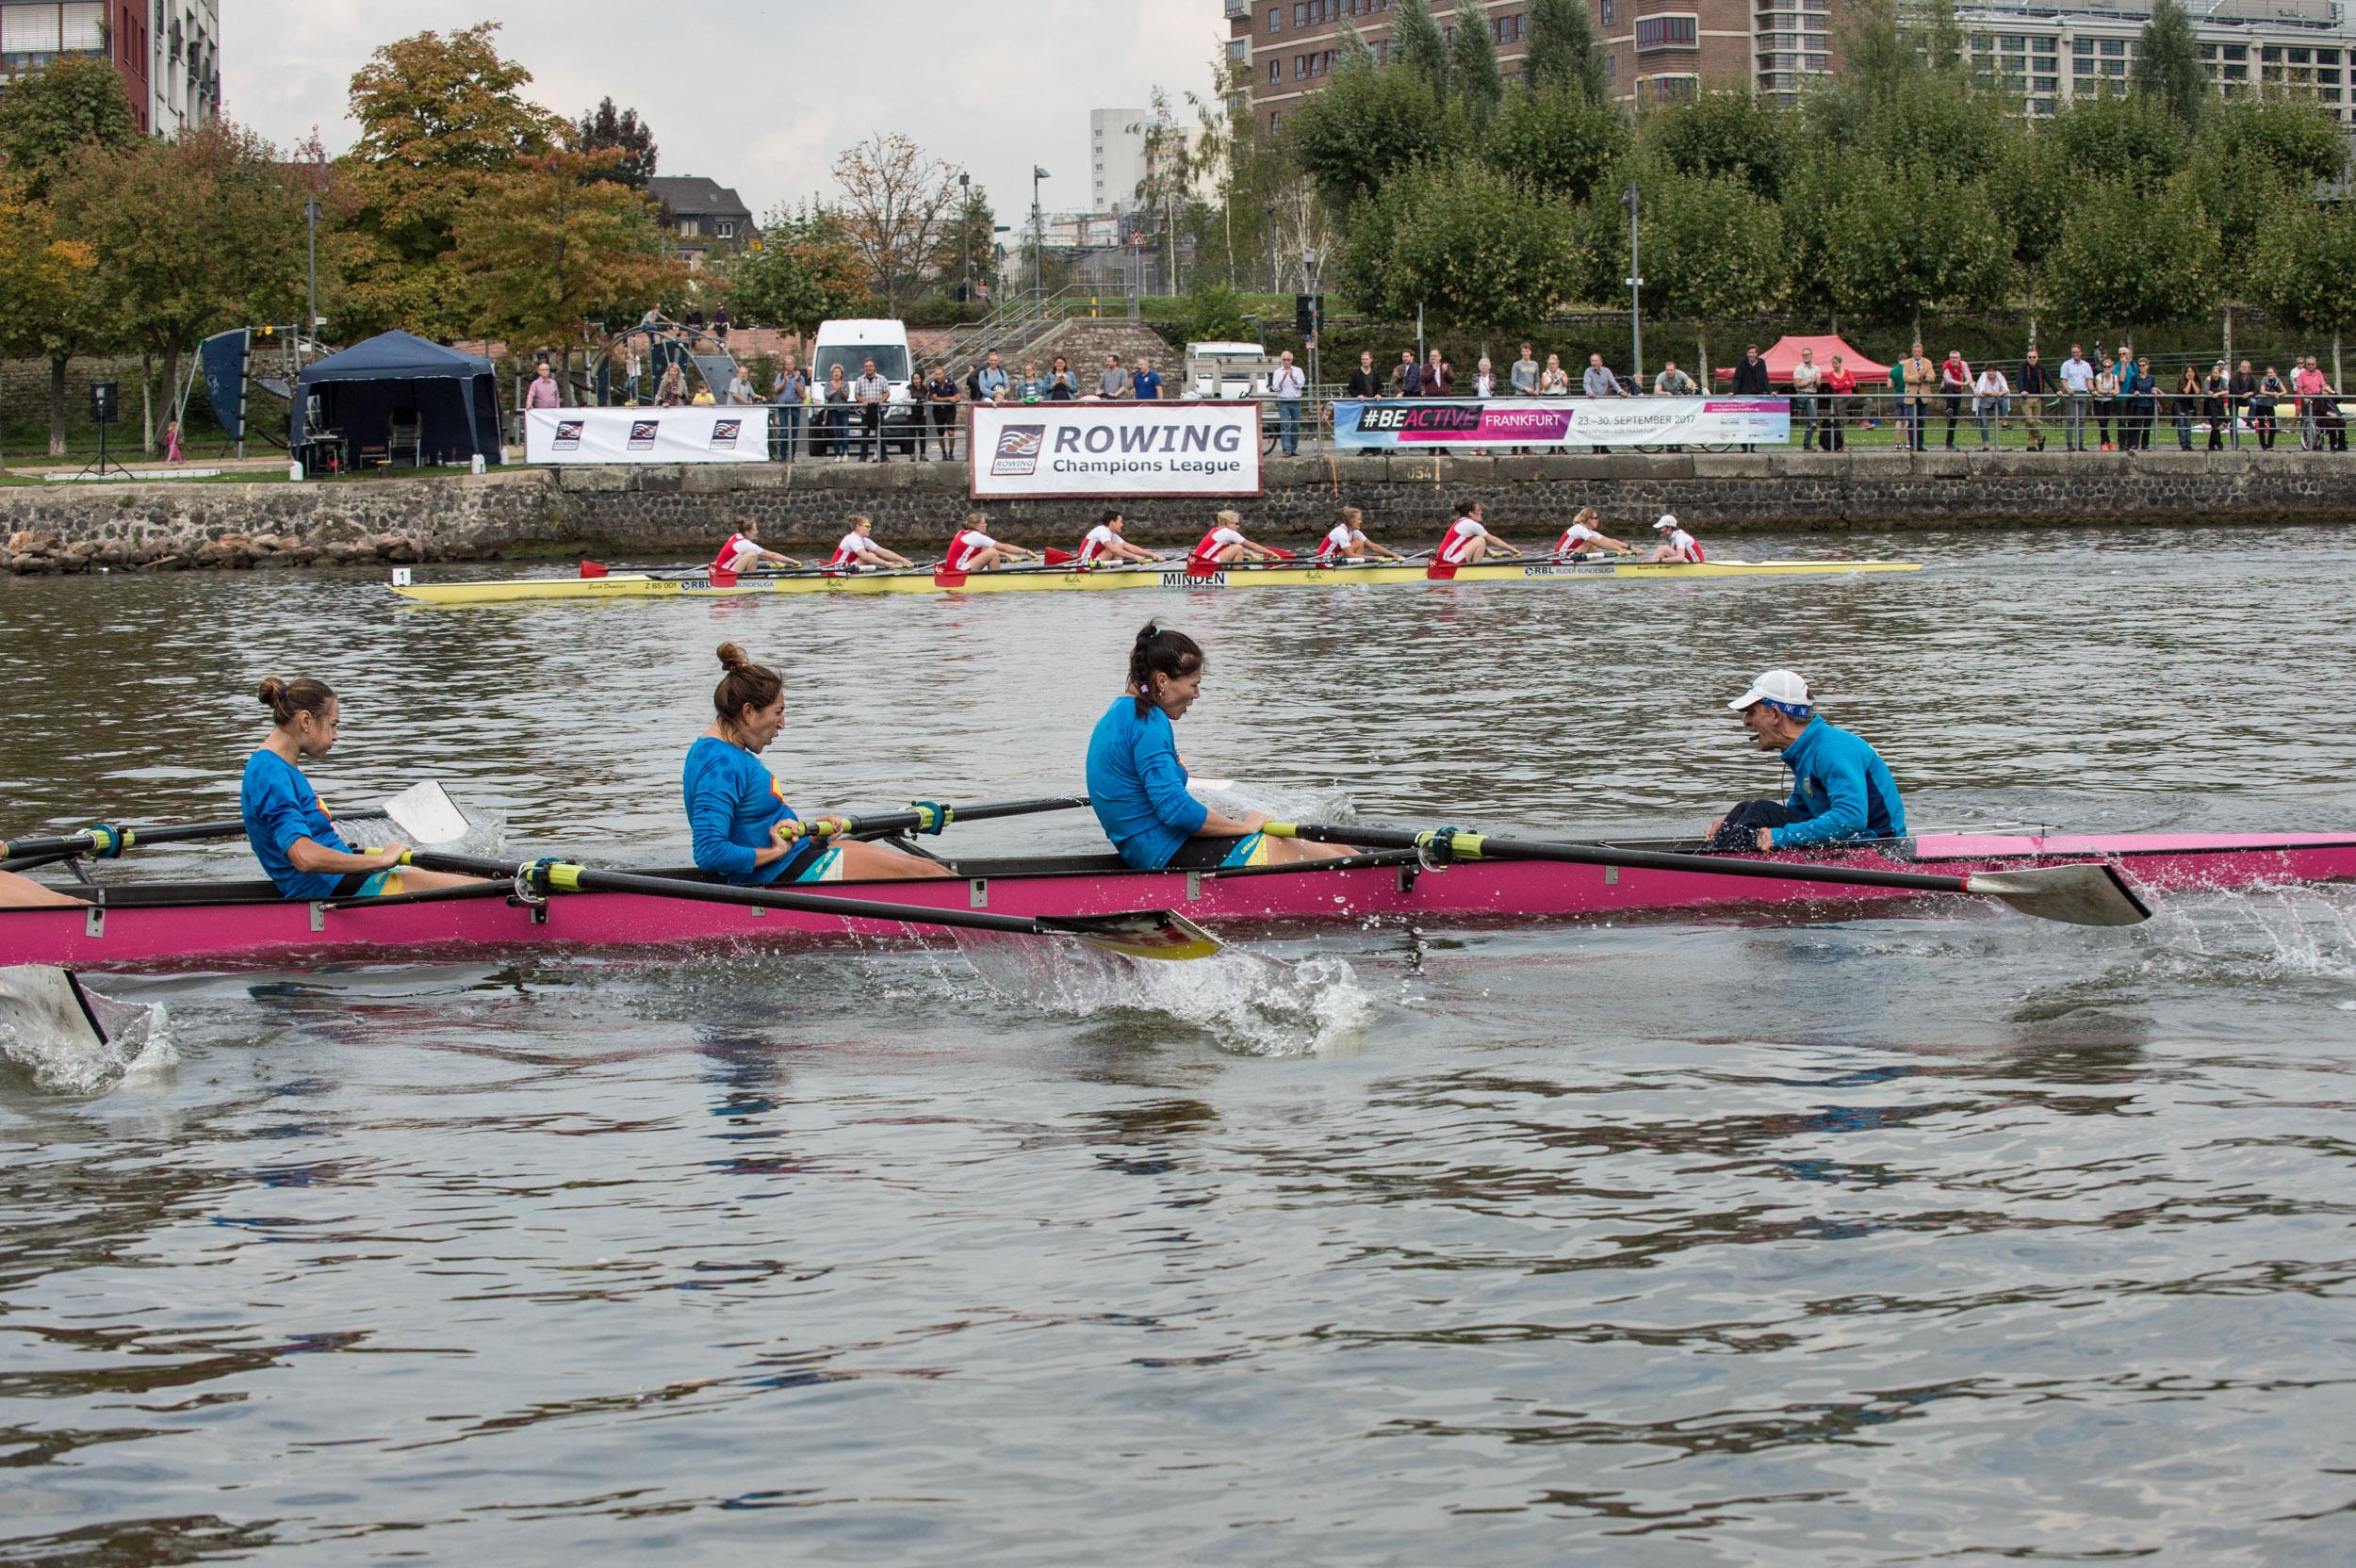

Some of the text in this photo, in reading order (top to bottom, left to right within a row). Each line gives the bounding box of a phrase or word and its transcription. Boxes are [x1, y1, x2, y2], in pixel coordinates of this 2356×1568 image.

[1364, 409, 1478, 427] #BEACTIVE
[1485, 415, 1561, 427] FRANKFURT
[1614, 416, 1672, 425] SEPTEMBER
[1675, 415, 1695, 424] 2017
[1054, 424, 1242, 453] ROWING
[1053, 459, 1240, 475] Champions League
[399, 571, 404, 581] 1
[1163, 572, 1225, 585] MINDEN
[691, 580, 712, 589] RBL
